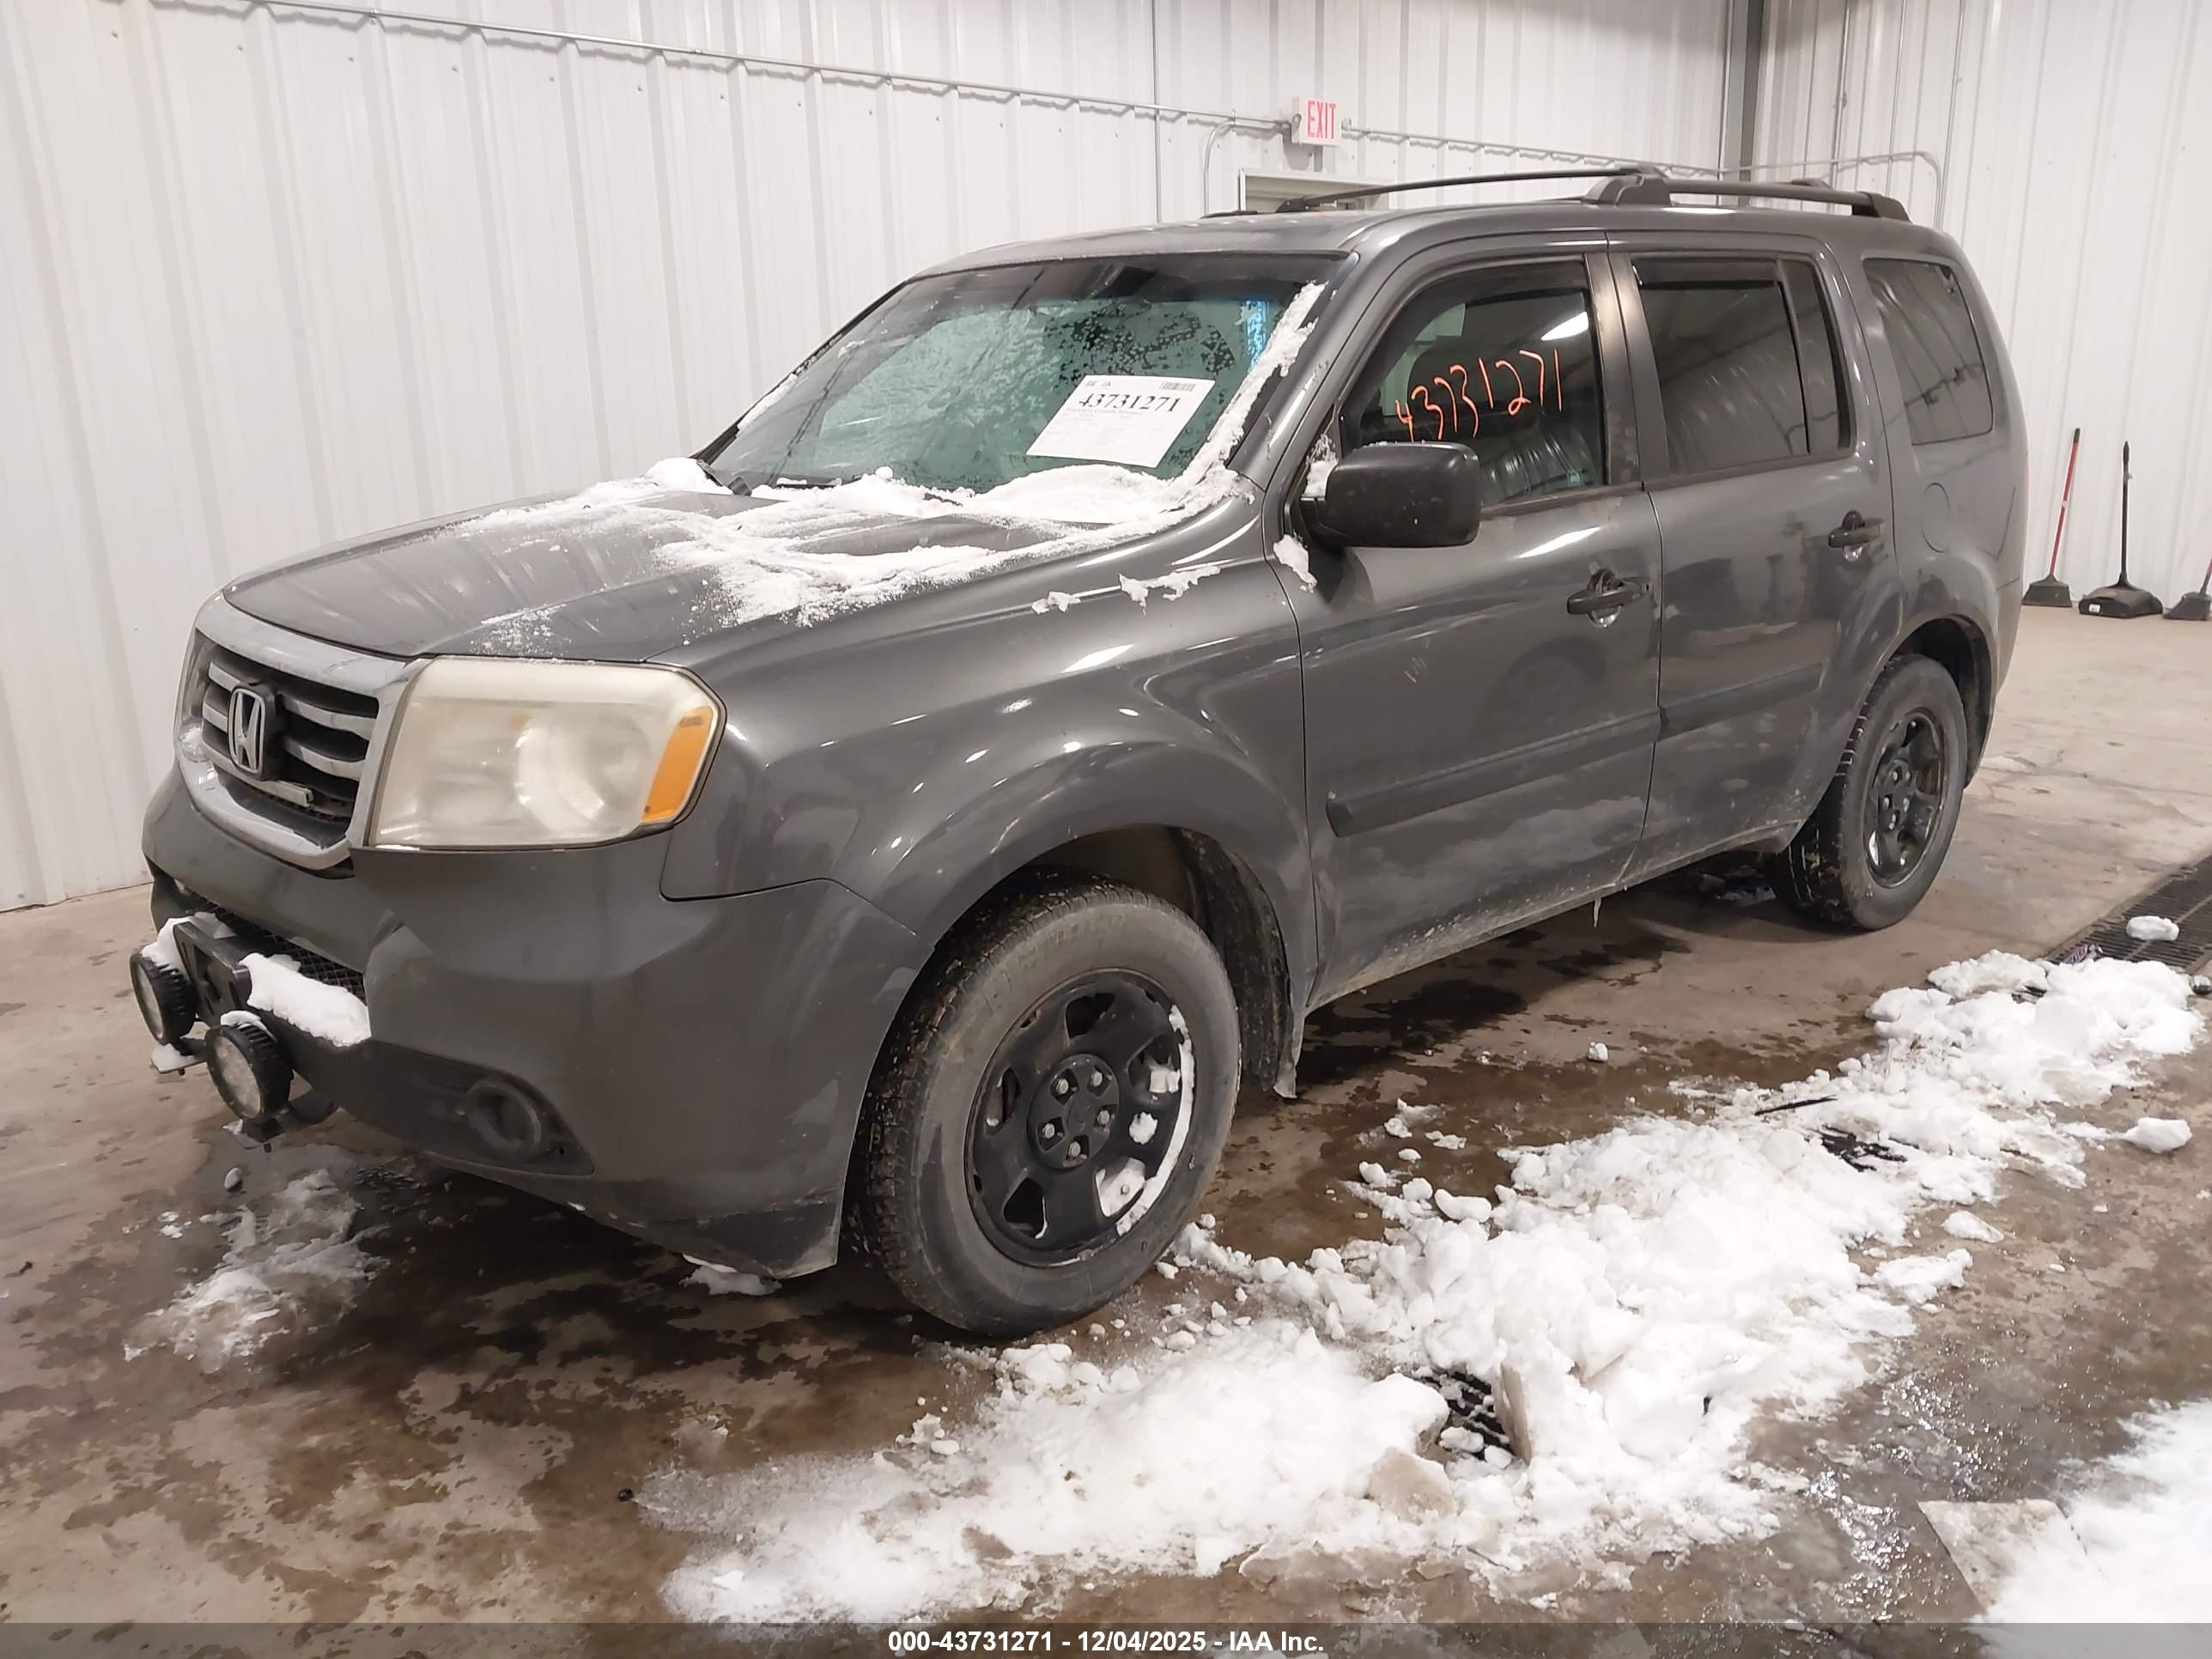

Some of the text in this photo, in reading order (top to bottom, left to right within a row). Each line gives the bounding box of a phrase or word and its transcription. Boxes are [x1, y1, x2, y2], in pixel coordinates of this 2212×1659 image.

[1307, 100, 1336, 139] EXIT
[1079, 392, 1181, 412] 43731271
[1395, 348, 1562, 442] 43731271
